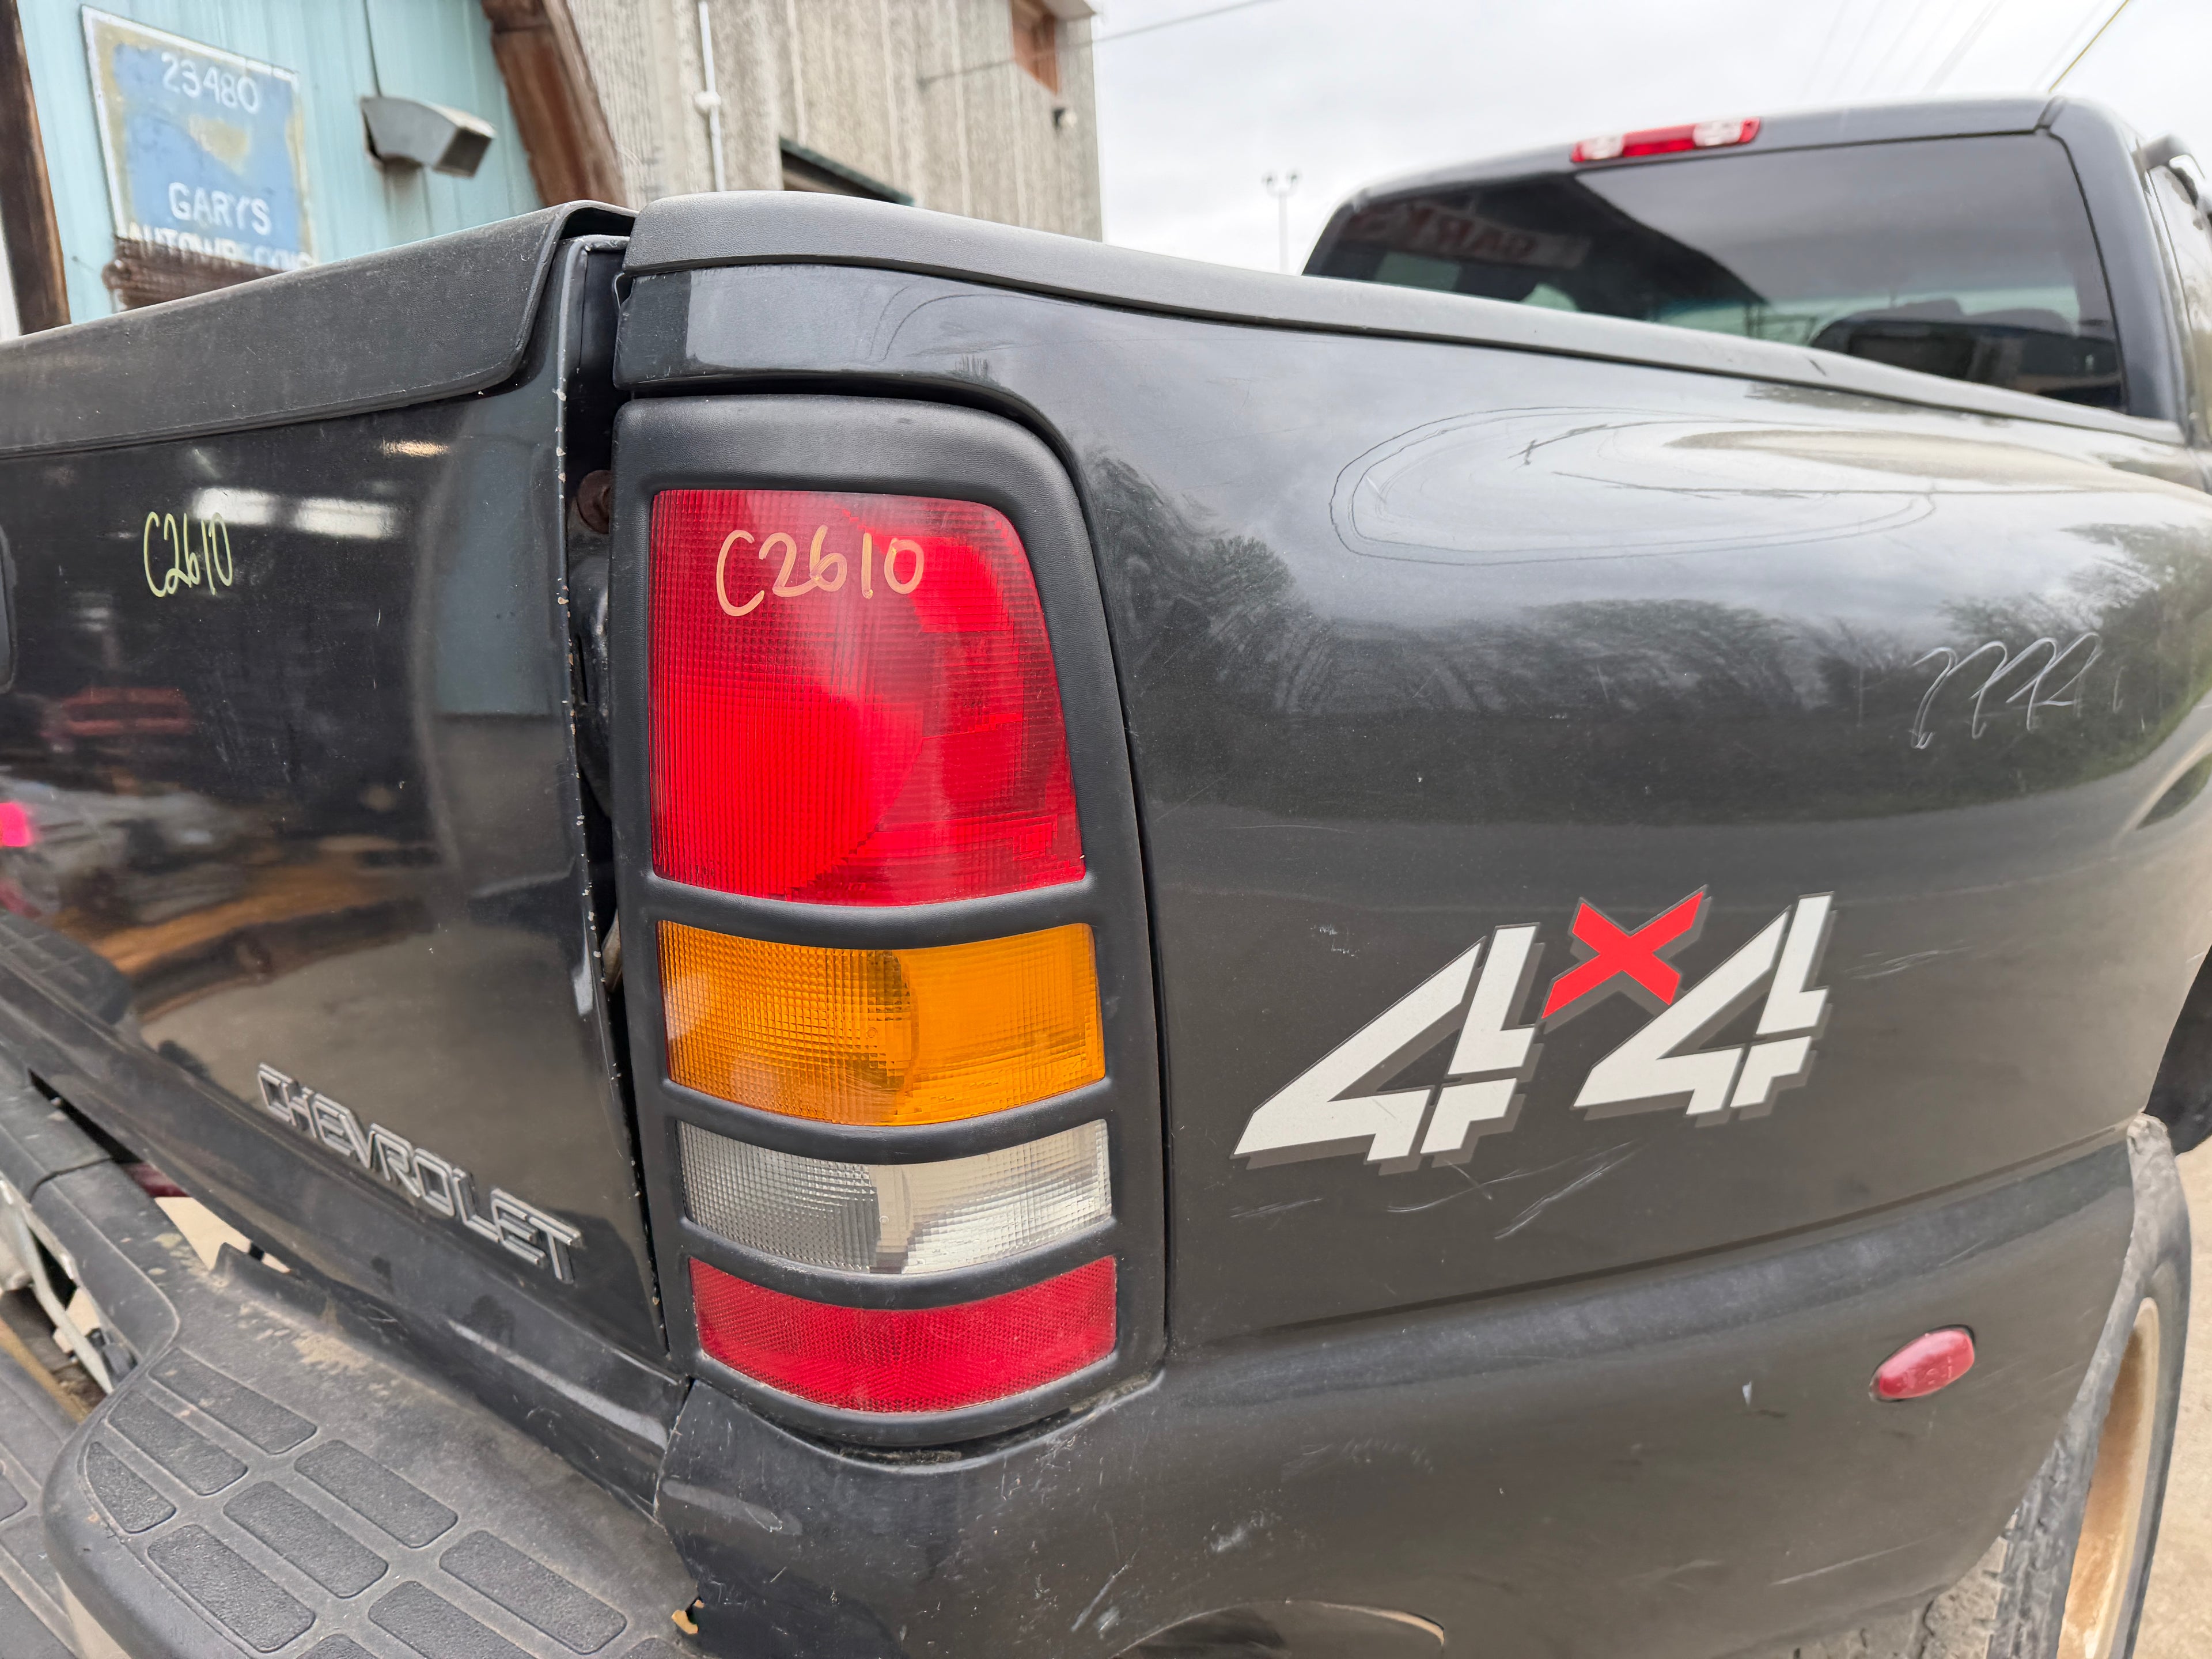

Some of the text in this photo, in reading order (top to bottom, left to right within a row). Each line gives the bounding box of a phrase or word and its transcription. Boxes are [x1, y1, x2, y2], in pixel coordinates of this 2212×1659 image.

[162, 52, 260, 113] 23480
[169, 182, 271, 235] GARYS
[143, 512, 233, 597] C2610
[716, 525, 924, 617] C2610
[257, 1062, 583, 1282] CHEVROLET
